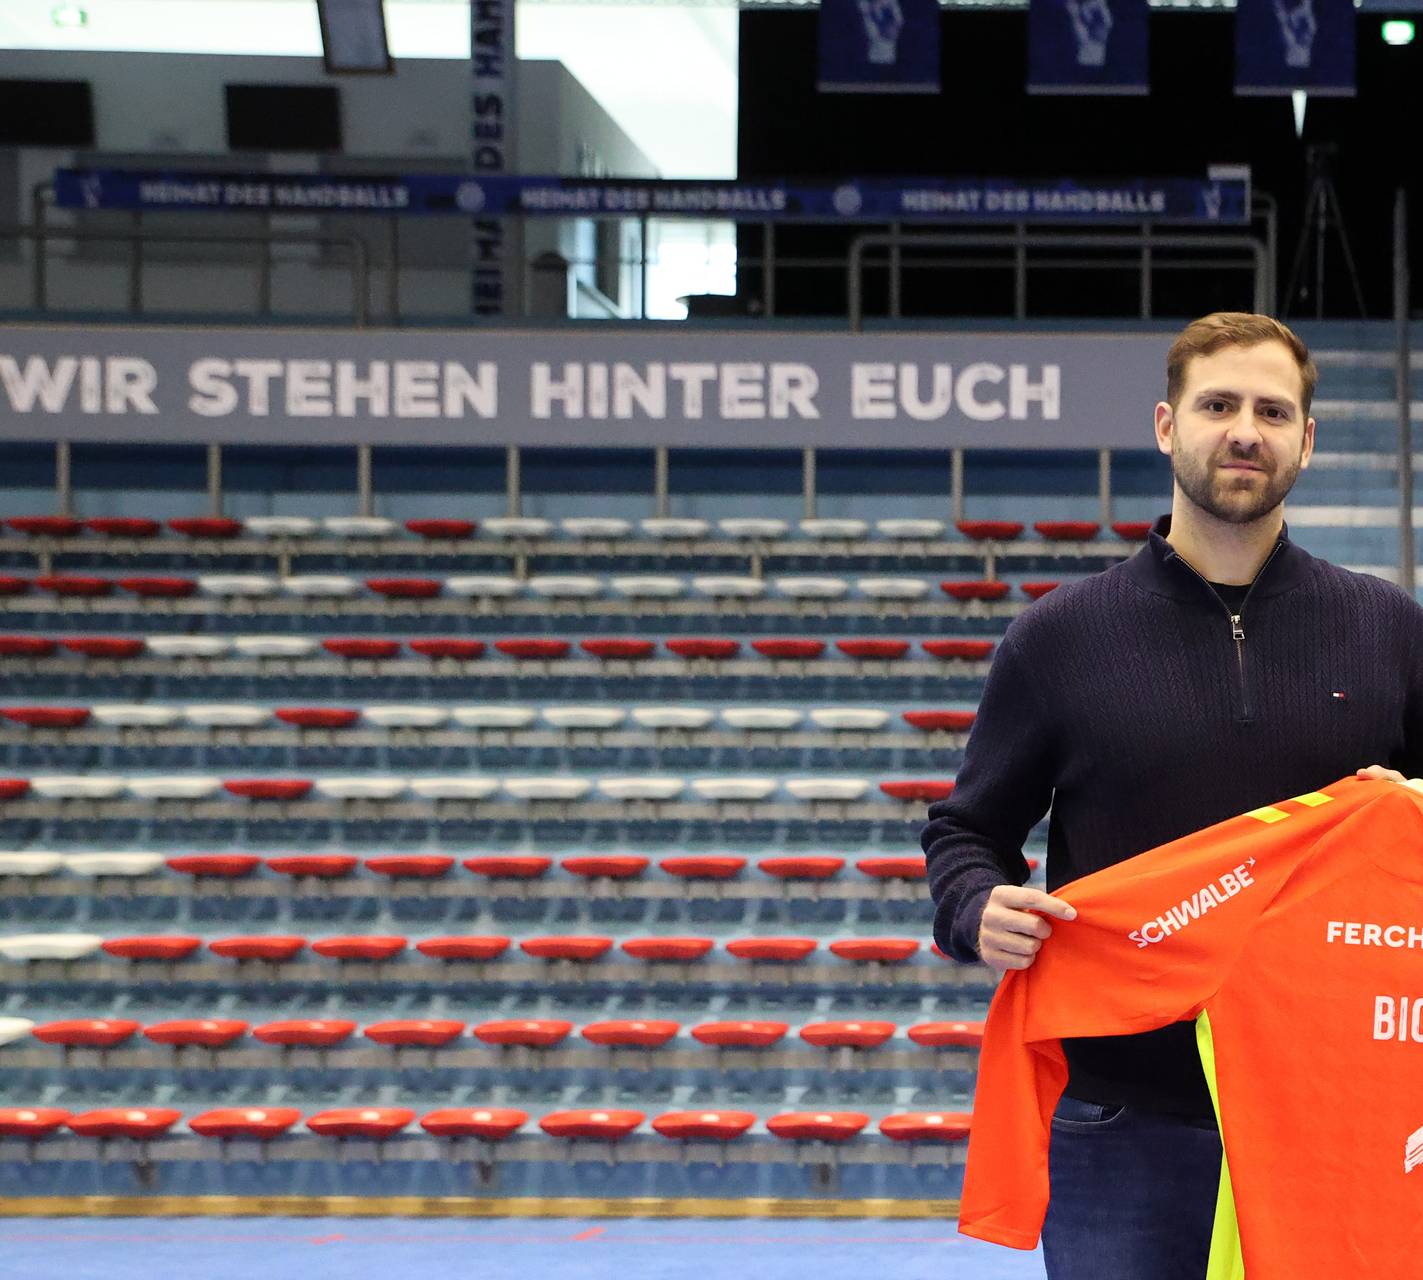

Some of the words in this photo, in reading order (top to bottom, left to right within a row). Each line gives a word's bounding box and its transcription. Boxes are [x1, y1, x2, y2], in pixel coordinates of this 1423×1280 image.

[902, 189, 980, 212] HEIMAT
[985, 189, 1029, 212] DES
[1033, 189, 1165, 212] HANDBALLS
[0, 355, 158, 415] WIR
[187, 358, 499, 419] STEHEN
[530, 361, 819, 421] HINTER
[851, 362, 1061, 421] EUCH
[1128, 864, 1256, 949] SCHWALBE
